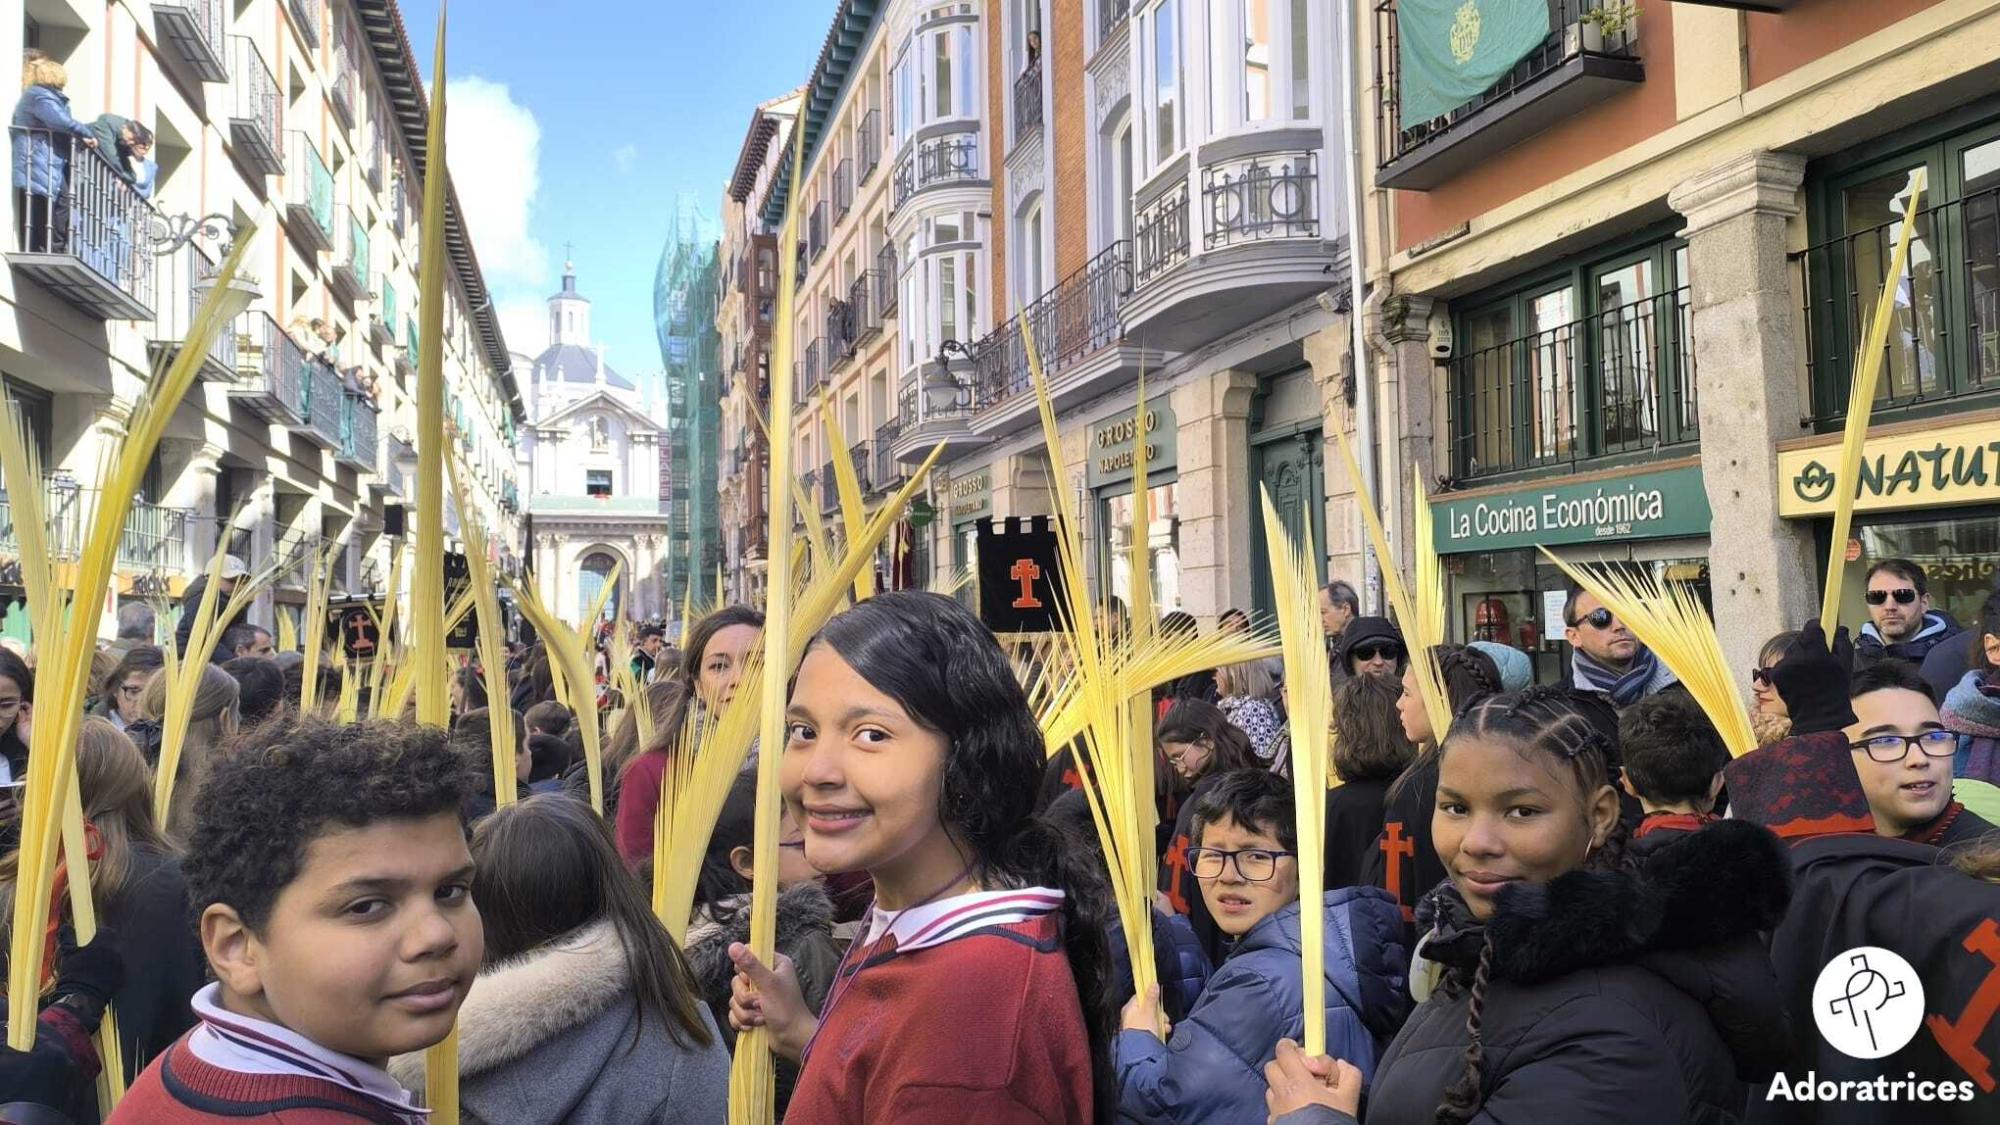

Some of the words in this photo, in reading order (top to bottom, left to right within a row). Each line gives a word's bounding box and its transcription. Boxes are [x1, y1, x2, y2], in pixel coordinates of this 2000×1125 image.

[1099, 444, 1156, 474] NAPOLETO
[953, 475, 983, 498] GROSSO
[1450, 508, 1471, 539] La
[1475, 500, 1538, 537] Cocina
[1543, 484, 1664, 530] Económica
[1595, 525, 1615, 537] desde
